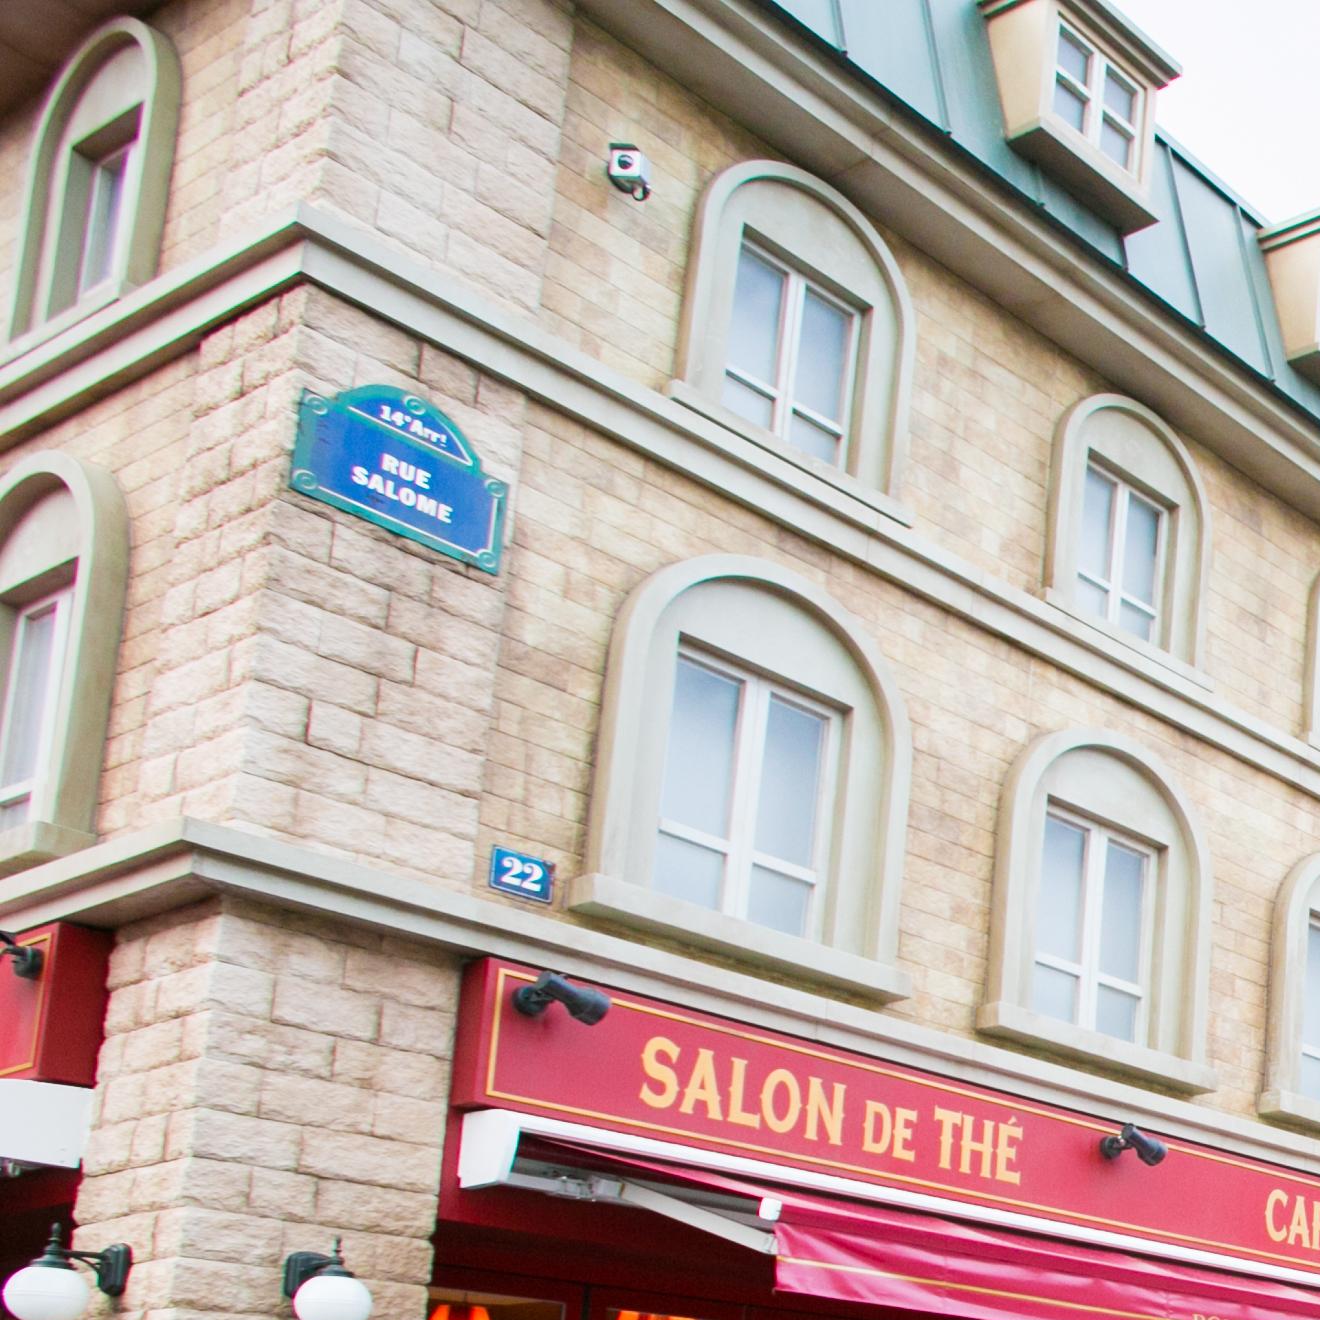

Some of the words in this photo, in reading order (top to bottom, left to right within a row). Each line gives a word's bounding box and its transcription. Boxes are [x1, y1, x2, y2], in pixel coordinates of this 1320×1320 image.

[351, 466, 453, 524] SALOME
[381, 453, 431, 490] RUE
[501, 856, 543, 892] 22
[639, 1036, 848, 1146] SALON
[862, 1100, 918, 1162] DE
[934, 1105, 1023, 1185] THÉ
